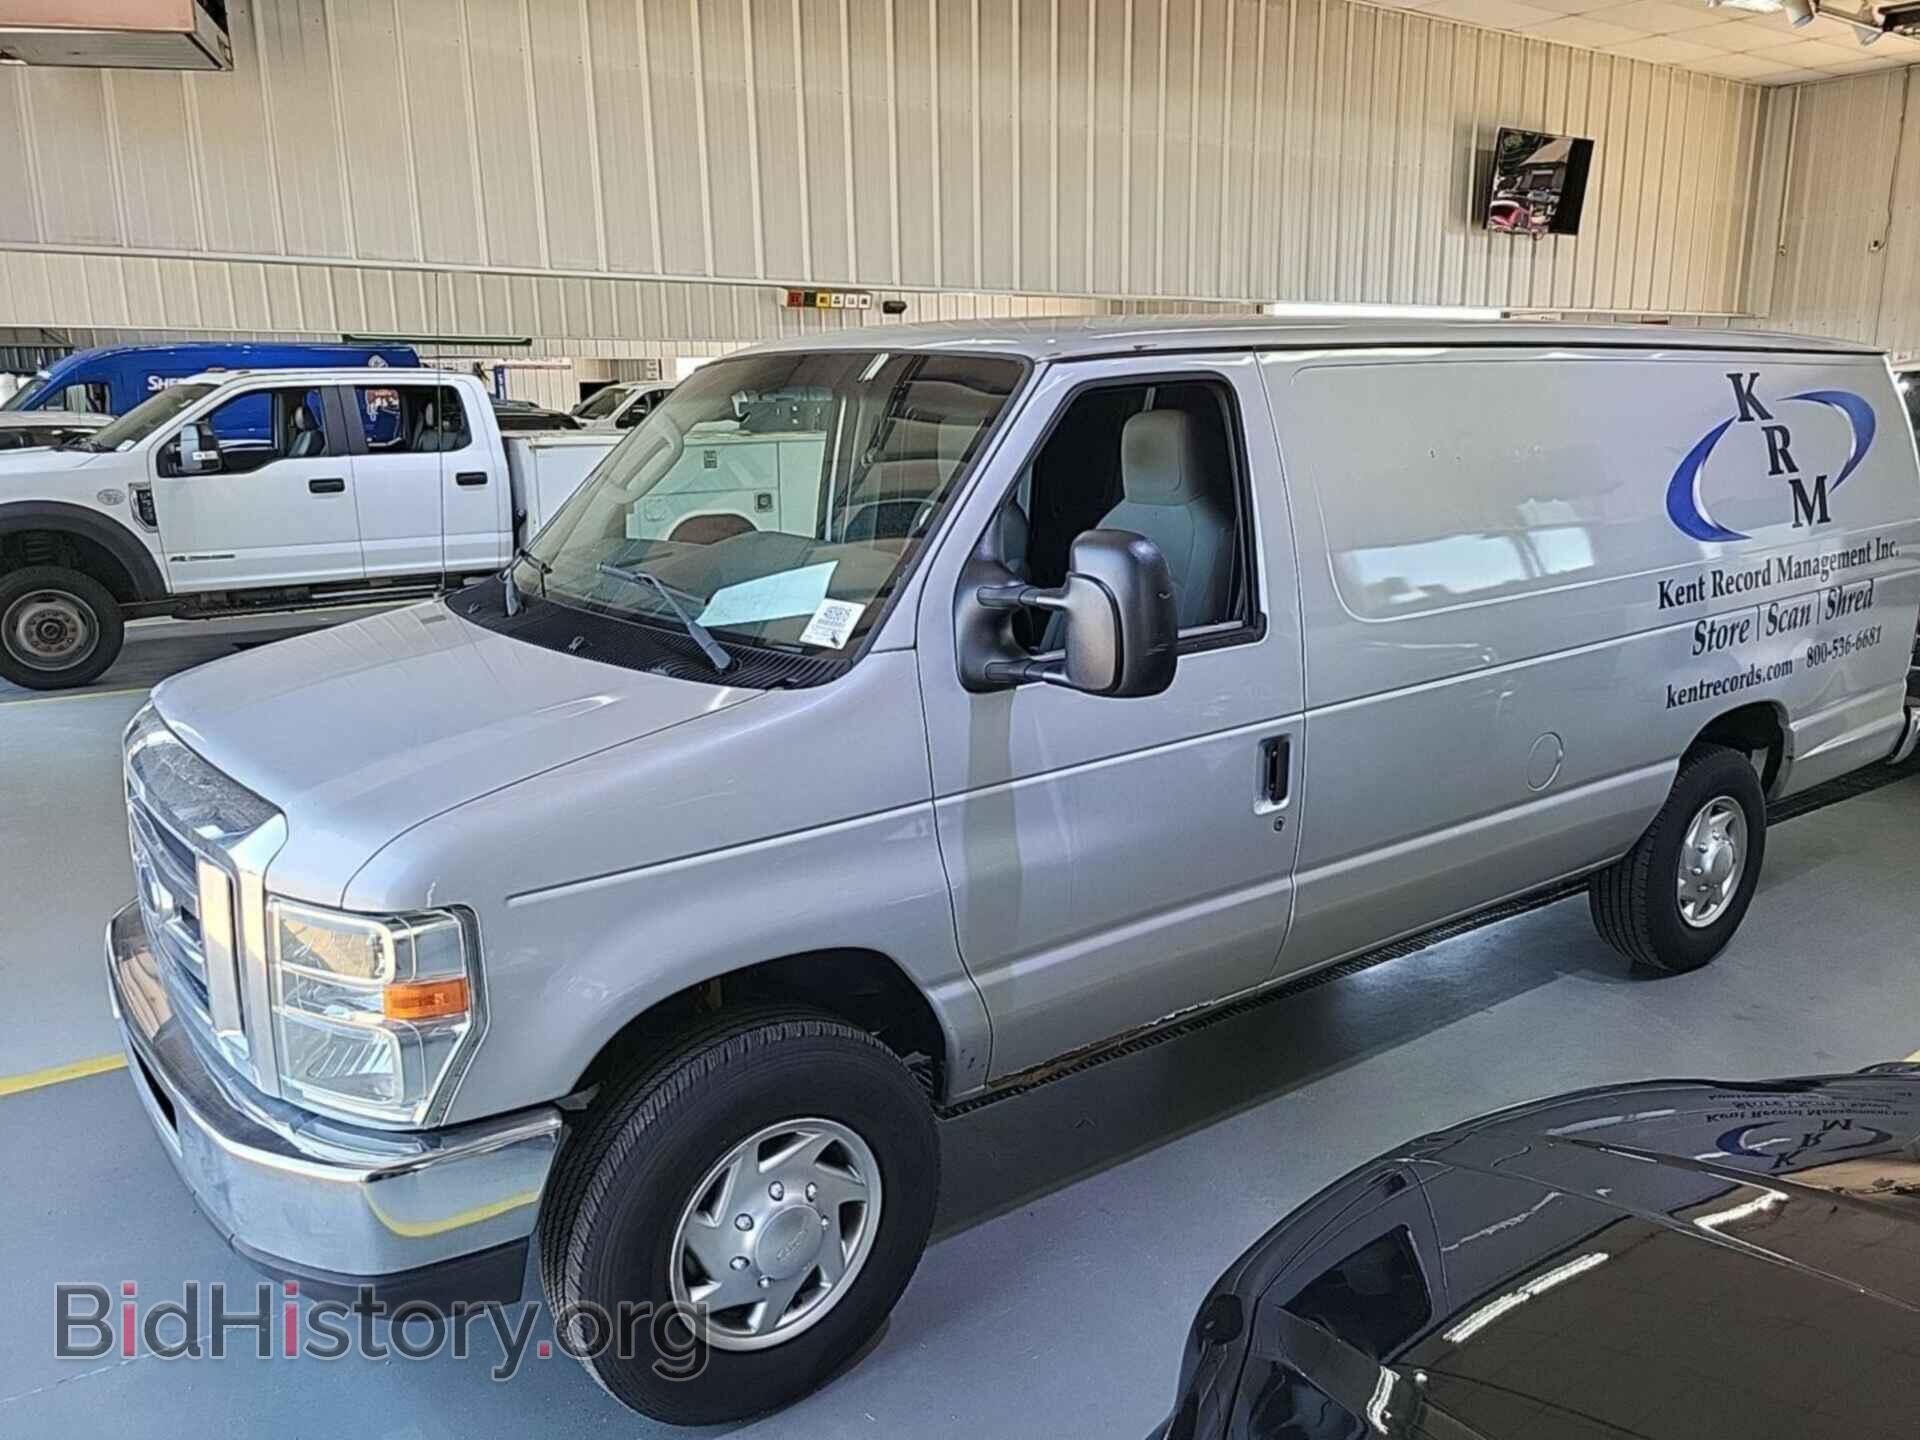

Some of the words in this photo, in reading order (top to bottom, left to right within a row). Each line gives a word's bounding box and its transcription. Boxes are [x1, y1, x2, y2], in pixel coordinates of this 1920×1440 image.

[1658, 577, 1706, 610] Kent
[1711, 560, 1771, 598] Record
[1777, 549, 1871, 582] Management
[1875, 537, 1900, 562] Inc.
[1692, 617, 1750, 656] Store
[1766, 602, 1812, 637] Scan
[1825, 578, 1874, 621] Shred
[1666, 664, 1793, 709] kentrecords.com
[1806, 625, 1883, 668] 800-536-6681
